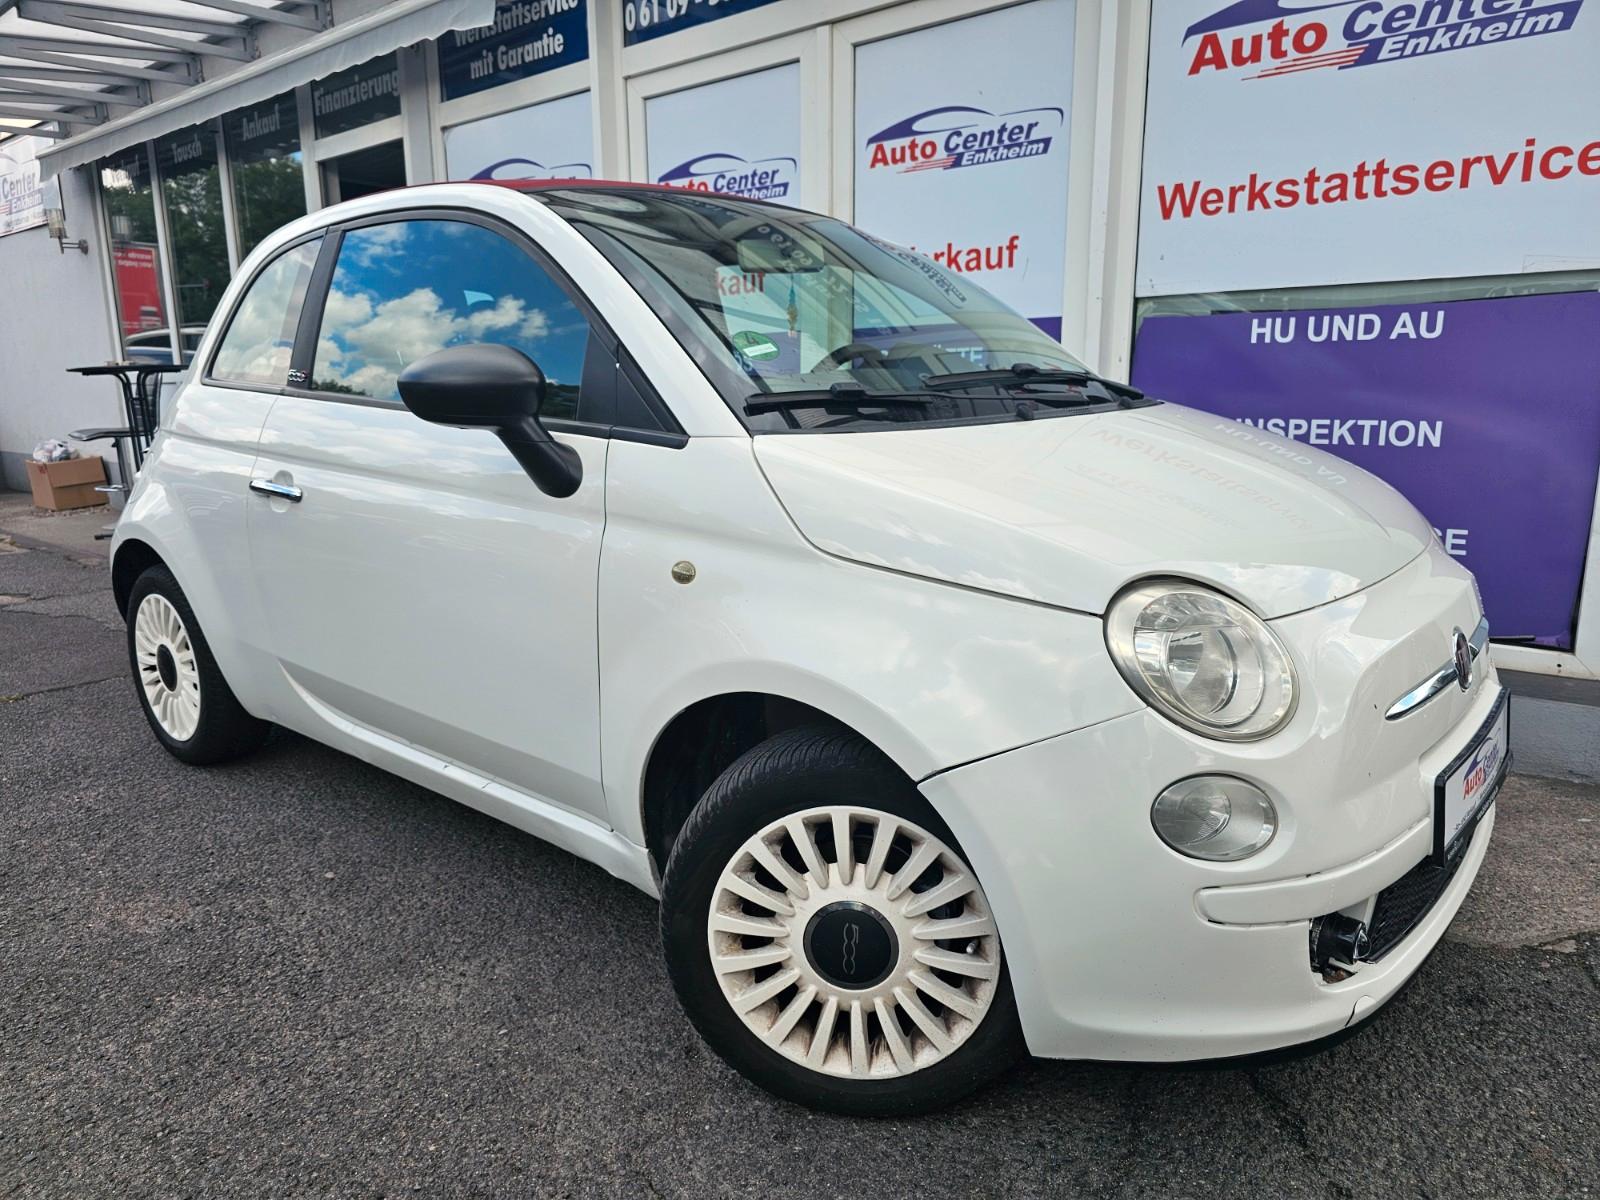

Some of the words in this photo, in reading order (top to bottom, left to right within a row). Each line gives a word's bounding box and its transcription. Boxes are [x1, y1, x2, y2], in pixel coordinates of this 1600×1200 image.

[470, 49, 494, 79] mit
[497, 27, 564, 70] Garantie
[1188, 19, 1328, 76] Auto
[1342, 0, 1534, 41] Cent
[1376, 10, 1564, 60] Enkheim
[314, 69, 400, 116] Finanzierung
[242, 104, 280, 141] Ankauf
[171, 133, 202, 164] Tausch
[869, 138, 937, 169] Auto
[944, 121, 1039, 154] Center
[960, 141, 1044, 166] Enkheim
[2, 172, 36, 199] Center
[713, 168, 780, 192] Center
[1157, 137, 1600, 220] Werkstattservice
[1250, 317, 1296, 344] HU
[1306, 314, 1381, 342] UND
[1390, 310, 1444, 339] AU
[1235, 418, 1443, 447] SPEKTION
